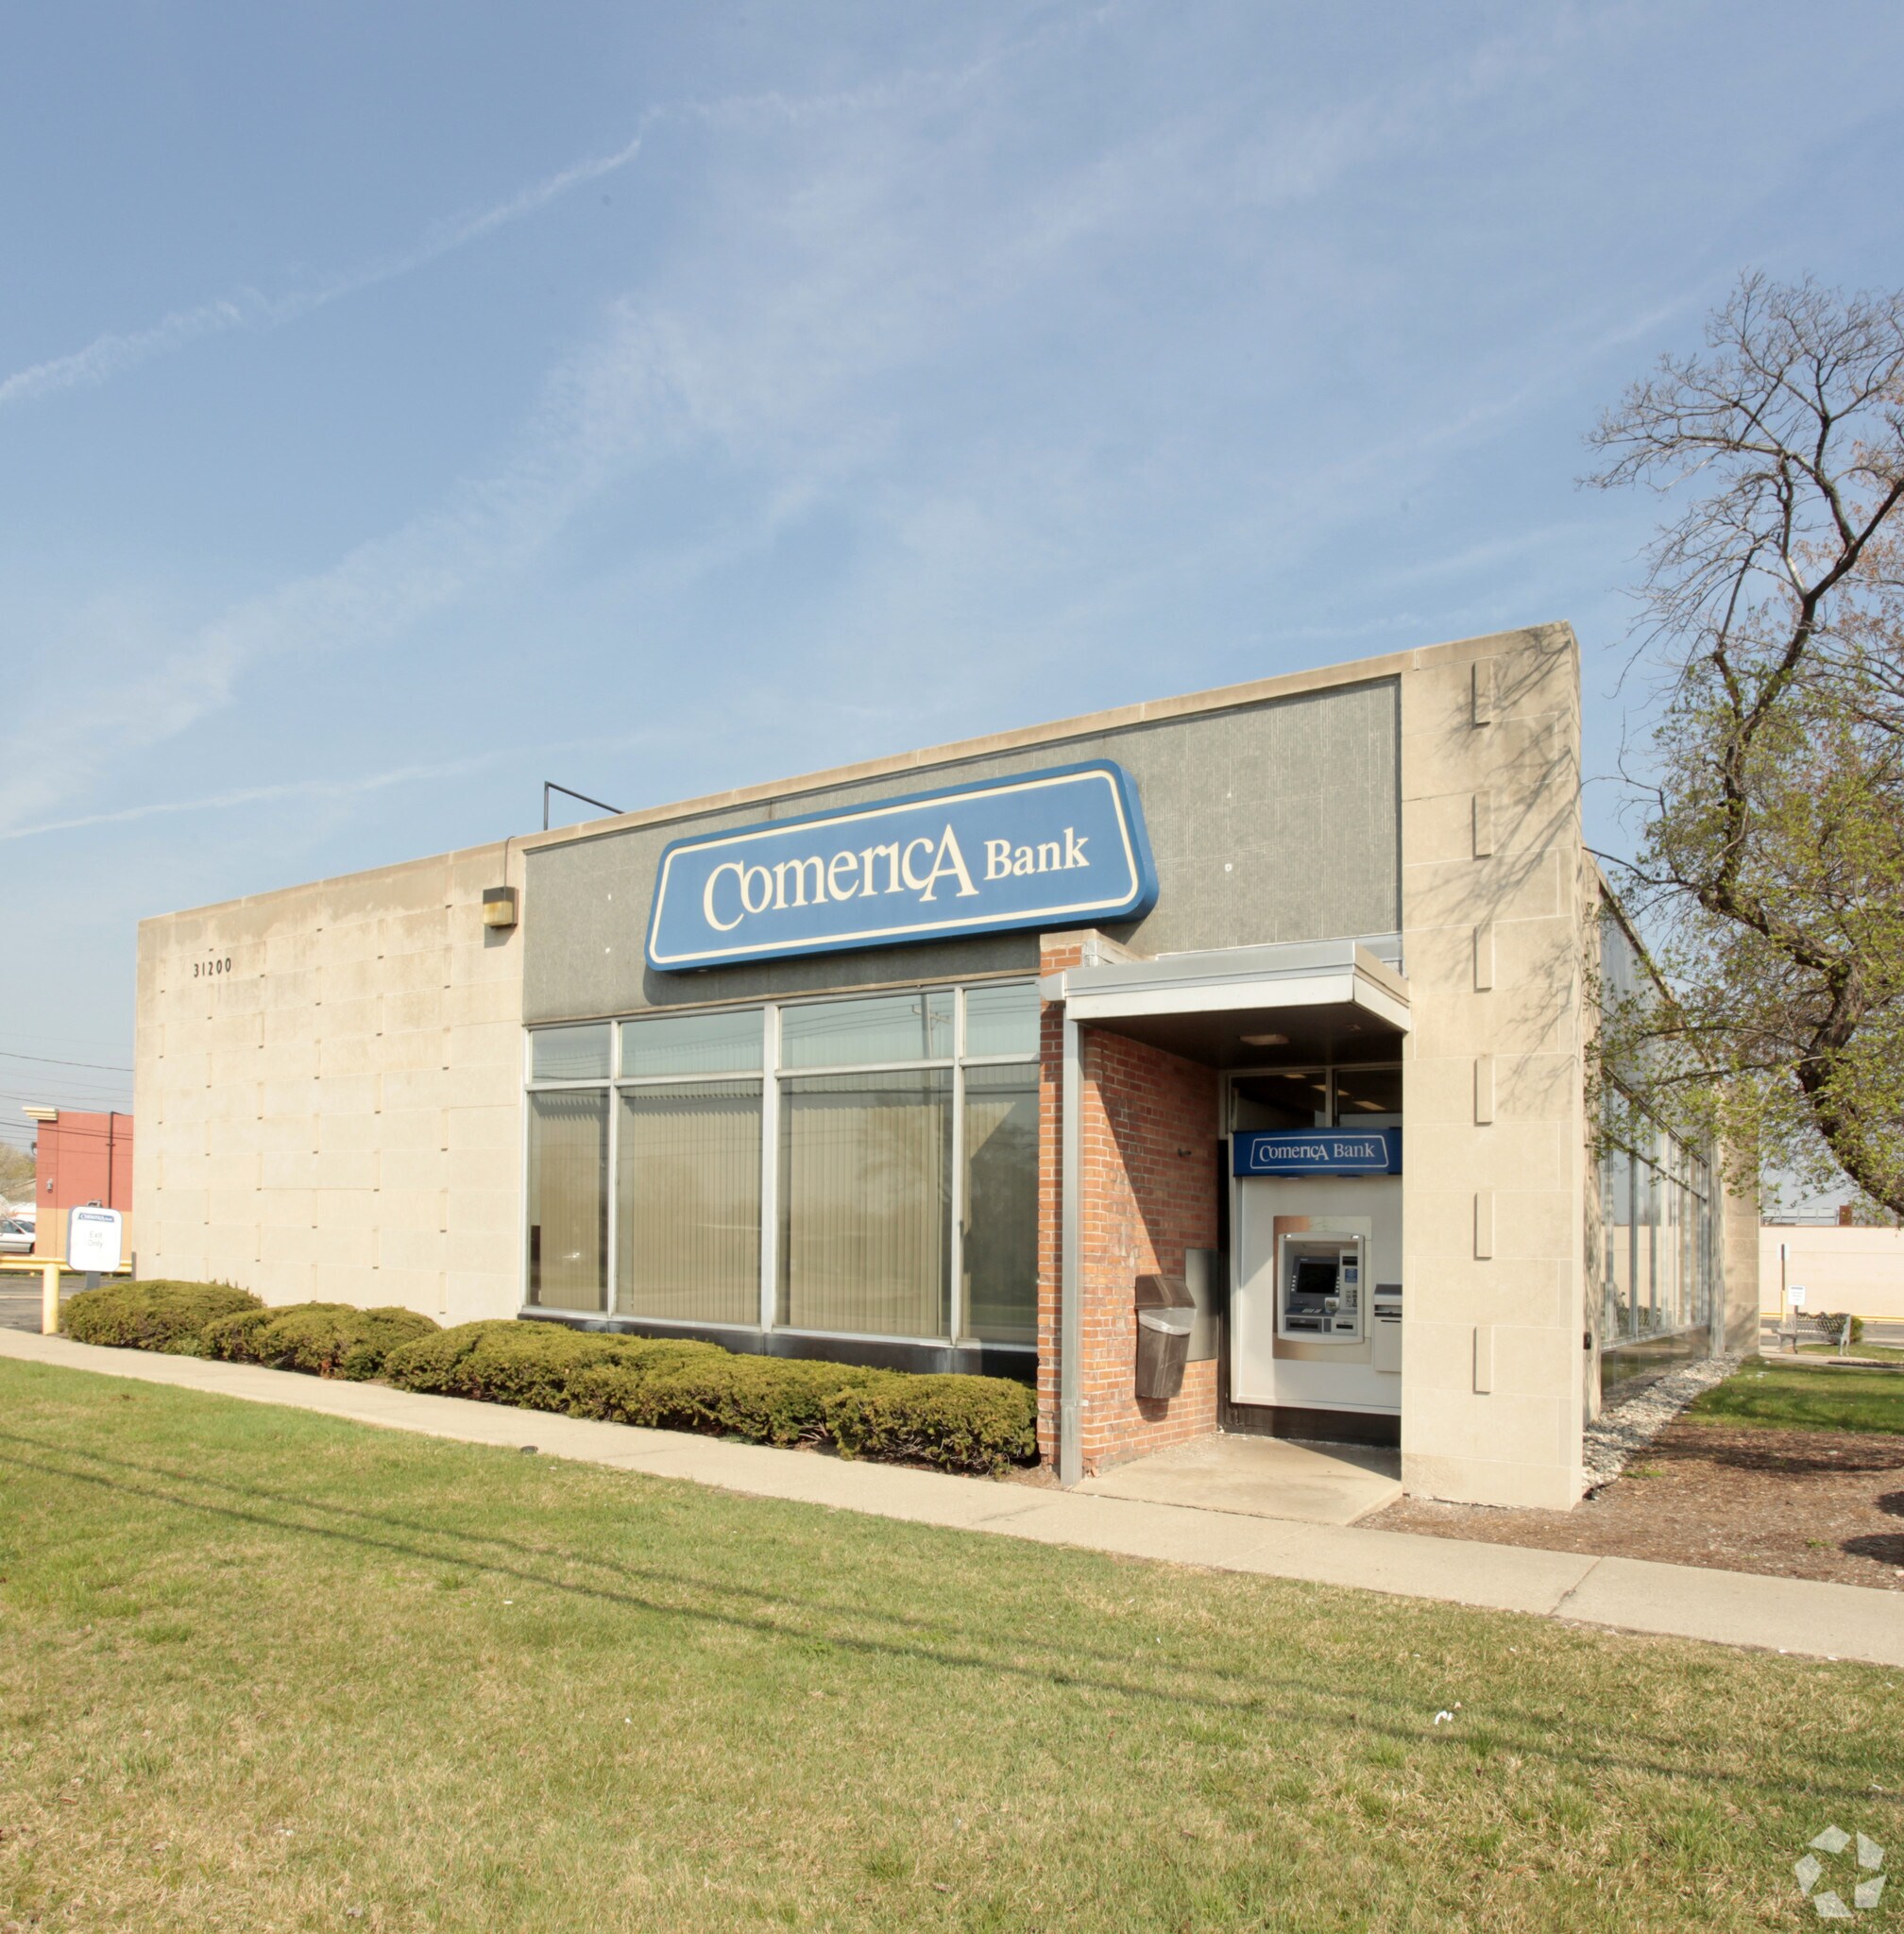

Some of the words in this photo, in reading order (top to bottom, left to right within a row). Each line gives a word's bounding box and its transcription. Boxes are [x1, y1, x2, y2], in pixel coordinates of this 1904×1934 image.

[983, 827, 1090, 881] Bank
[194, 958, 231, 978] 31200
[1334, 1143, 1375, 1158] Bank
